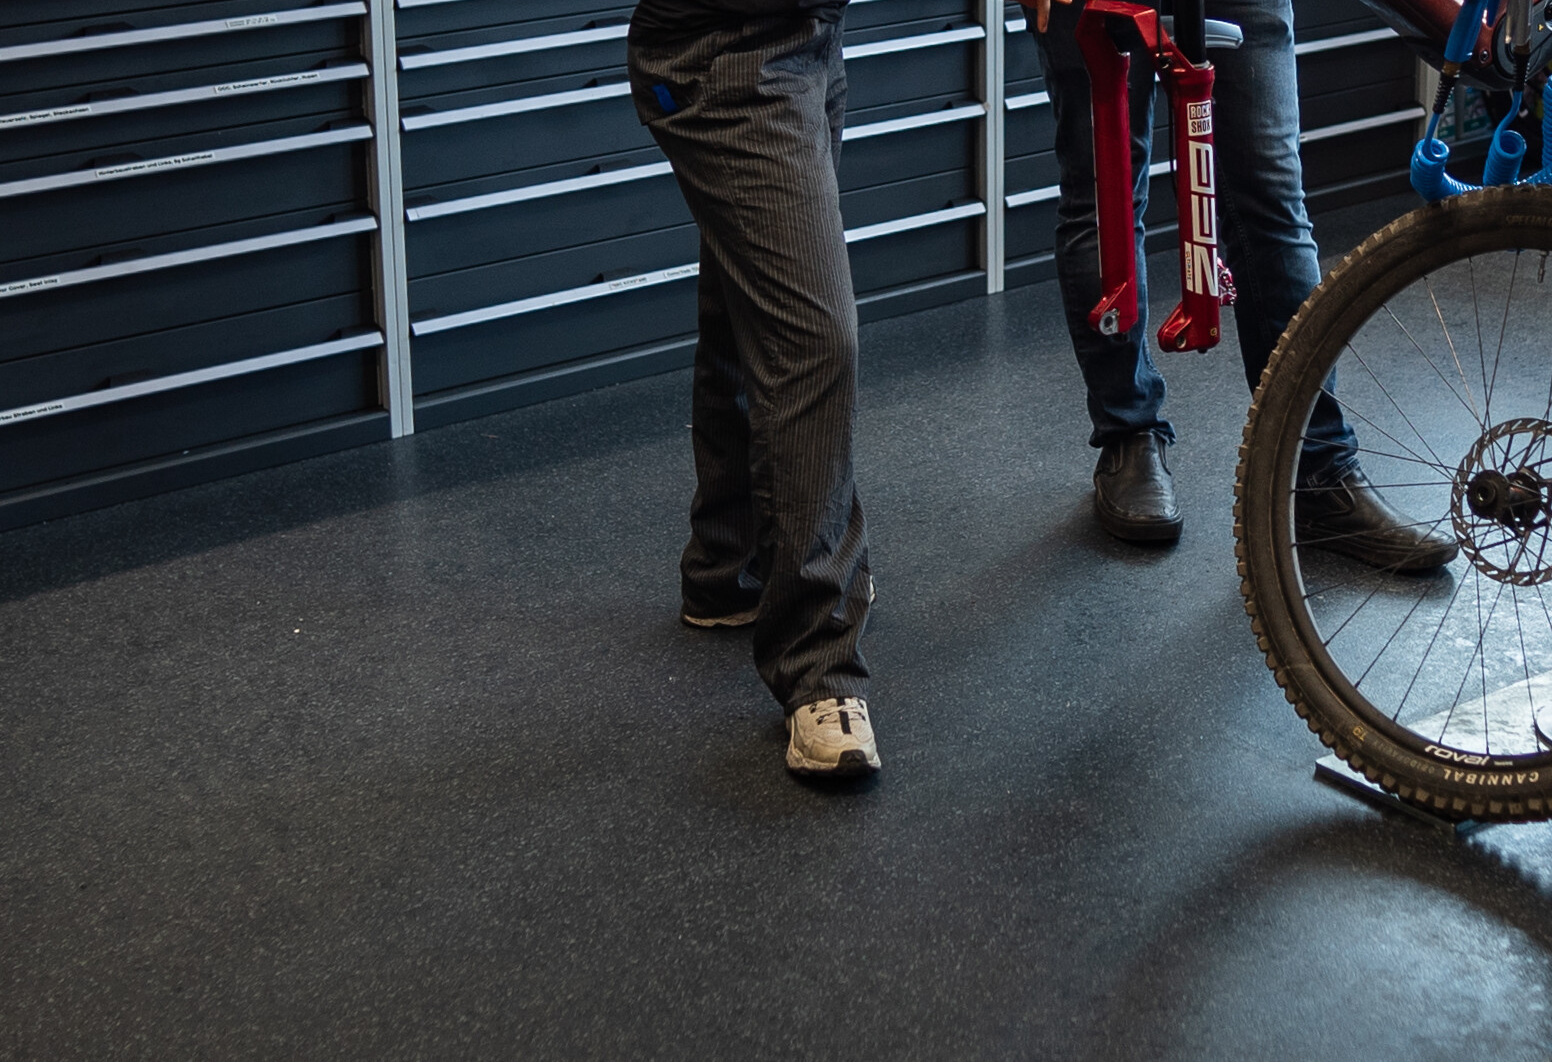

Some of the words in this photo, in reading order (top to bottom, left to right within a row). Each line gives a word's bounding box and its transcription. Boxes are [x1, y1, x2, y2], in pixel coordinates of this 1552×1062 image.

[1190, 103, 1212, 120] ROCK
[1191, 120, 1212, 134] SHOX
[1424, 744, 1492, 767] roval
[1443, 768, 1540, 786] CANNIBAL
